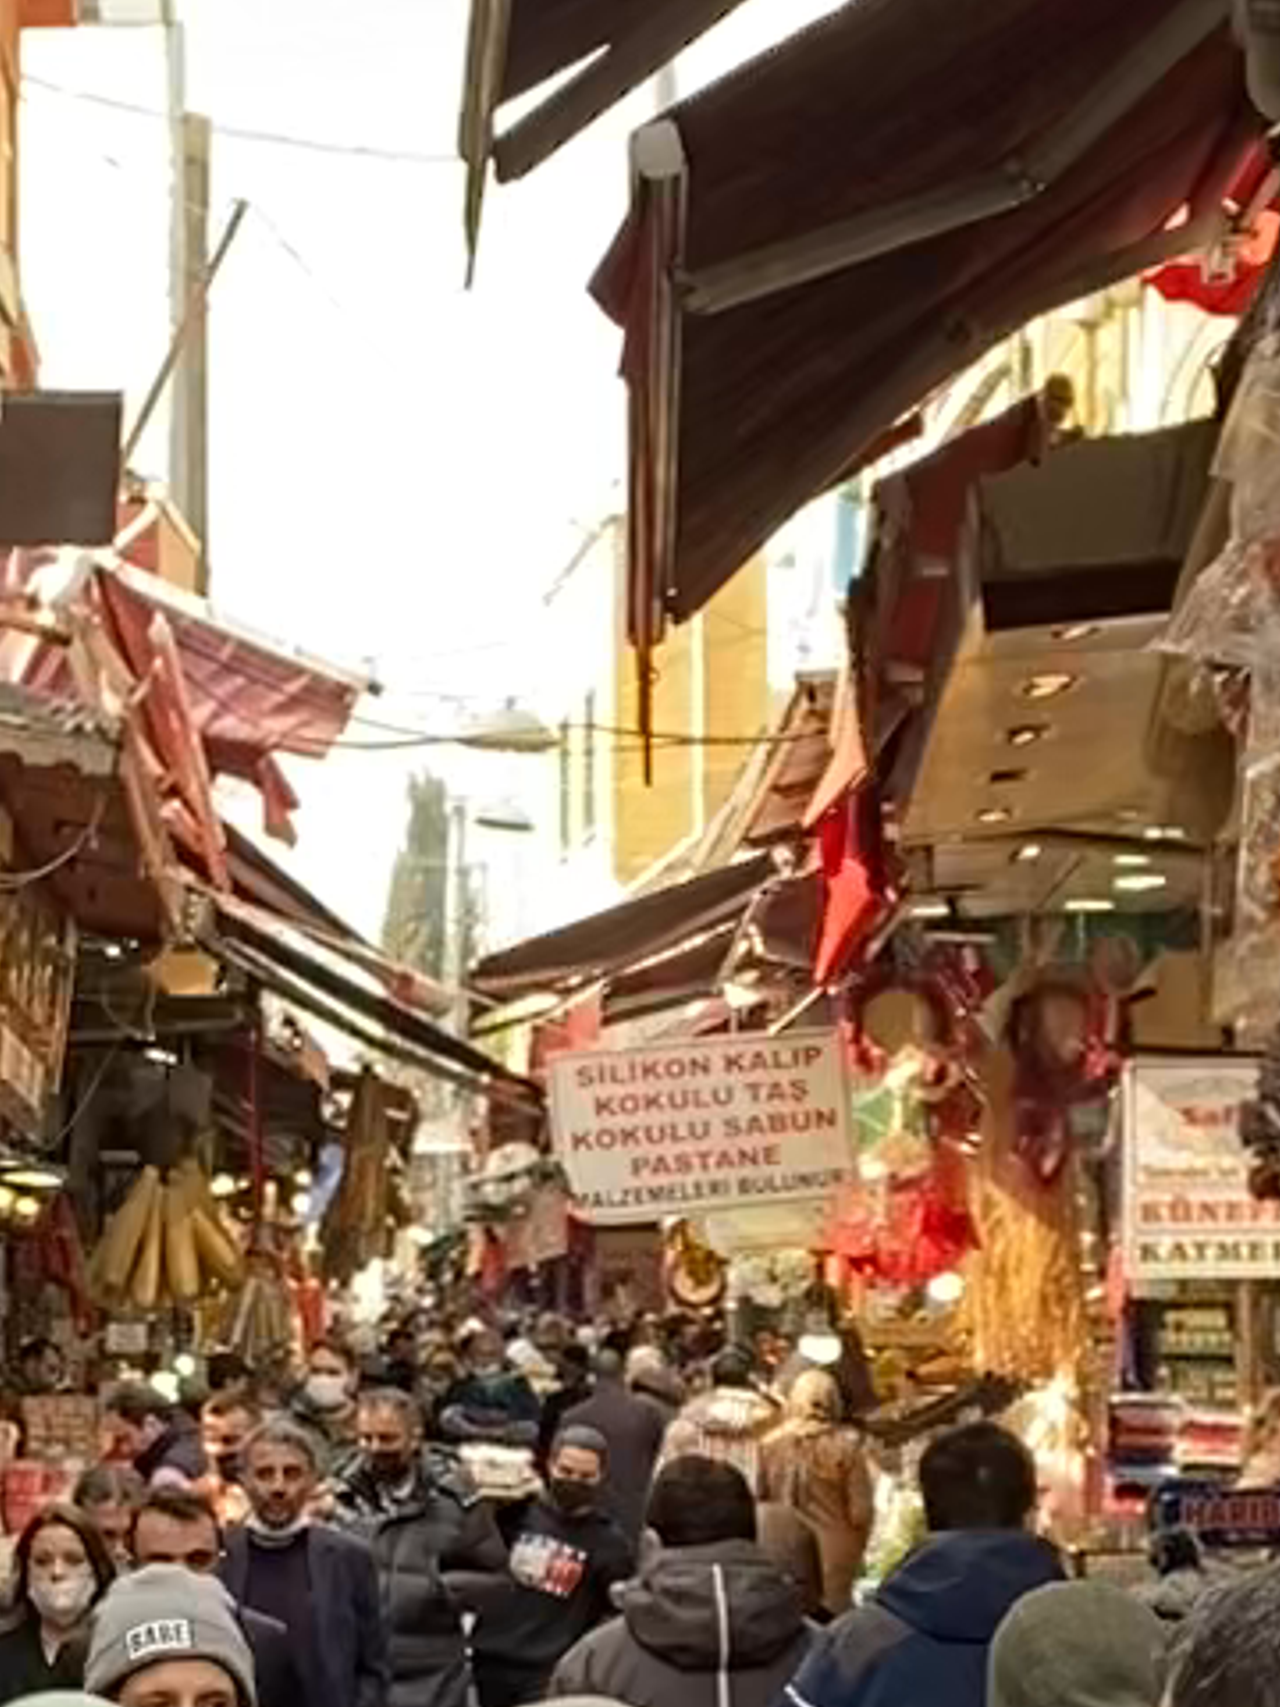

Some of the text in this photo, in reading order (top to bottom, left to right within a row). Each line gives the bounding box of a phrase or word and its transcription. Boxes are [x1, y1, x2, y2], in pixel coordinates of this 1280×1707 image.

[723, 1045, 823, 1074] KALIP
[593, 1086, 734, 1118] KOKULU
[570, 1107, 838, 1151] KOKULU SABUN
[629, 1143, 783, 1178] PASTANE
